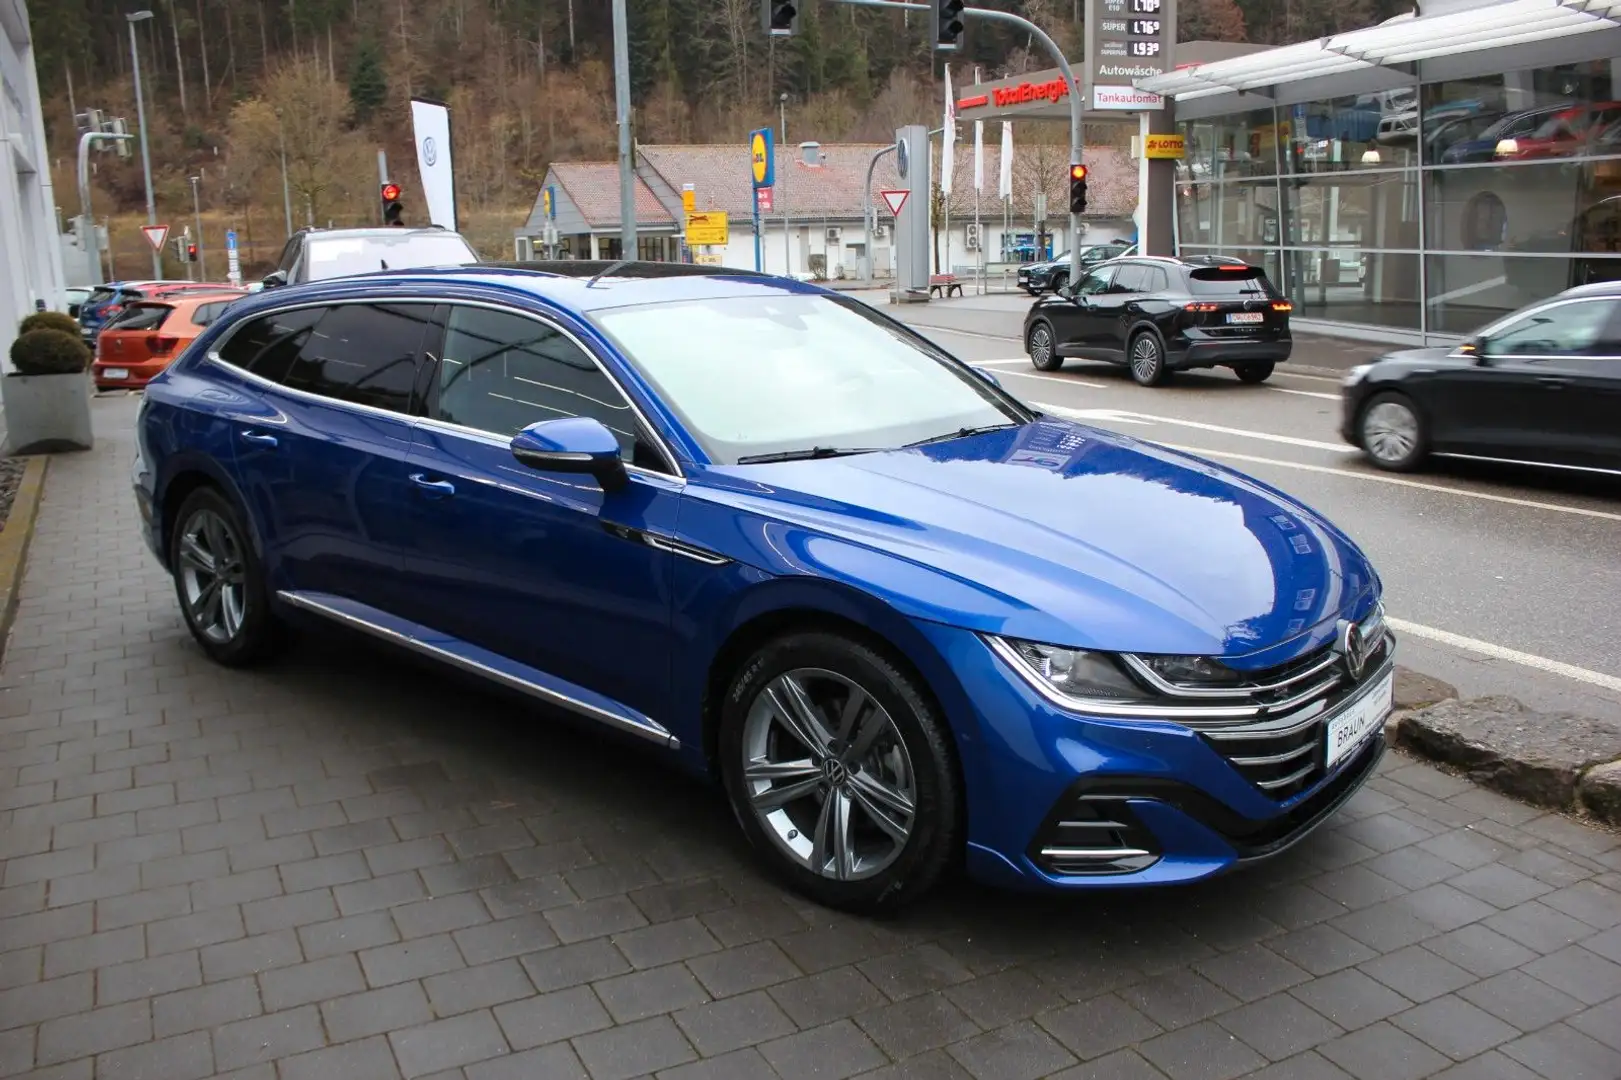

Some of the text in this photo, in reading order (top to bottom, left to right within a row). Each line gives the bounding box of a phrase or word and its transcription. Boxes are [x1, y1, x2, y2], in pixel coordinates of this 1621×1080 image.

[1102, 22, 1126, 31] SUPER
[1099, 64, 1163, 76] Autowäsche
[1097, 92, 1164, 104] Tankautomat
[1158, 140, 1184, 149] LOTTO
[1337, 714, 1365, 748] BRAUN
